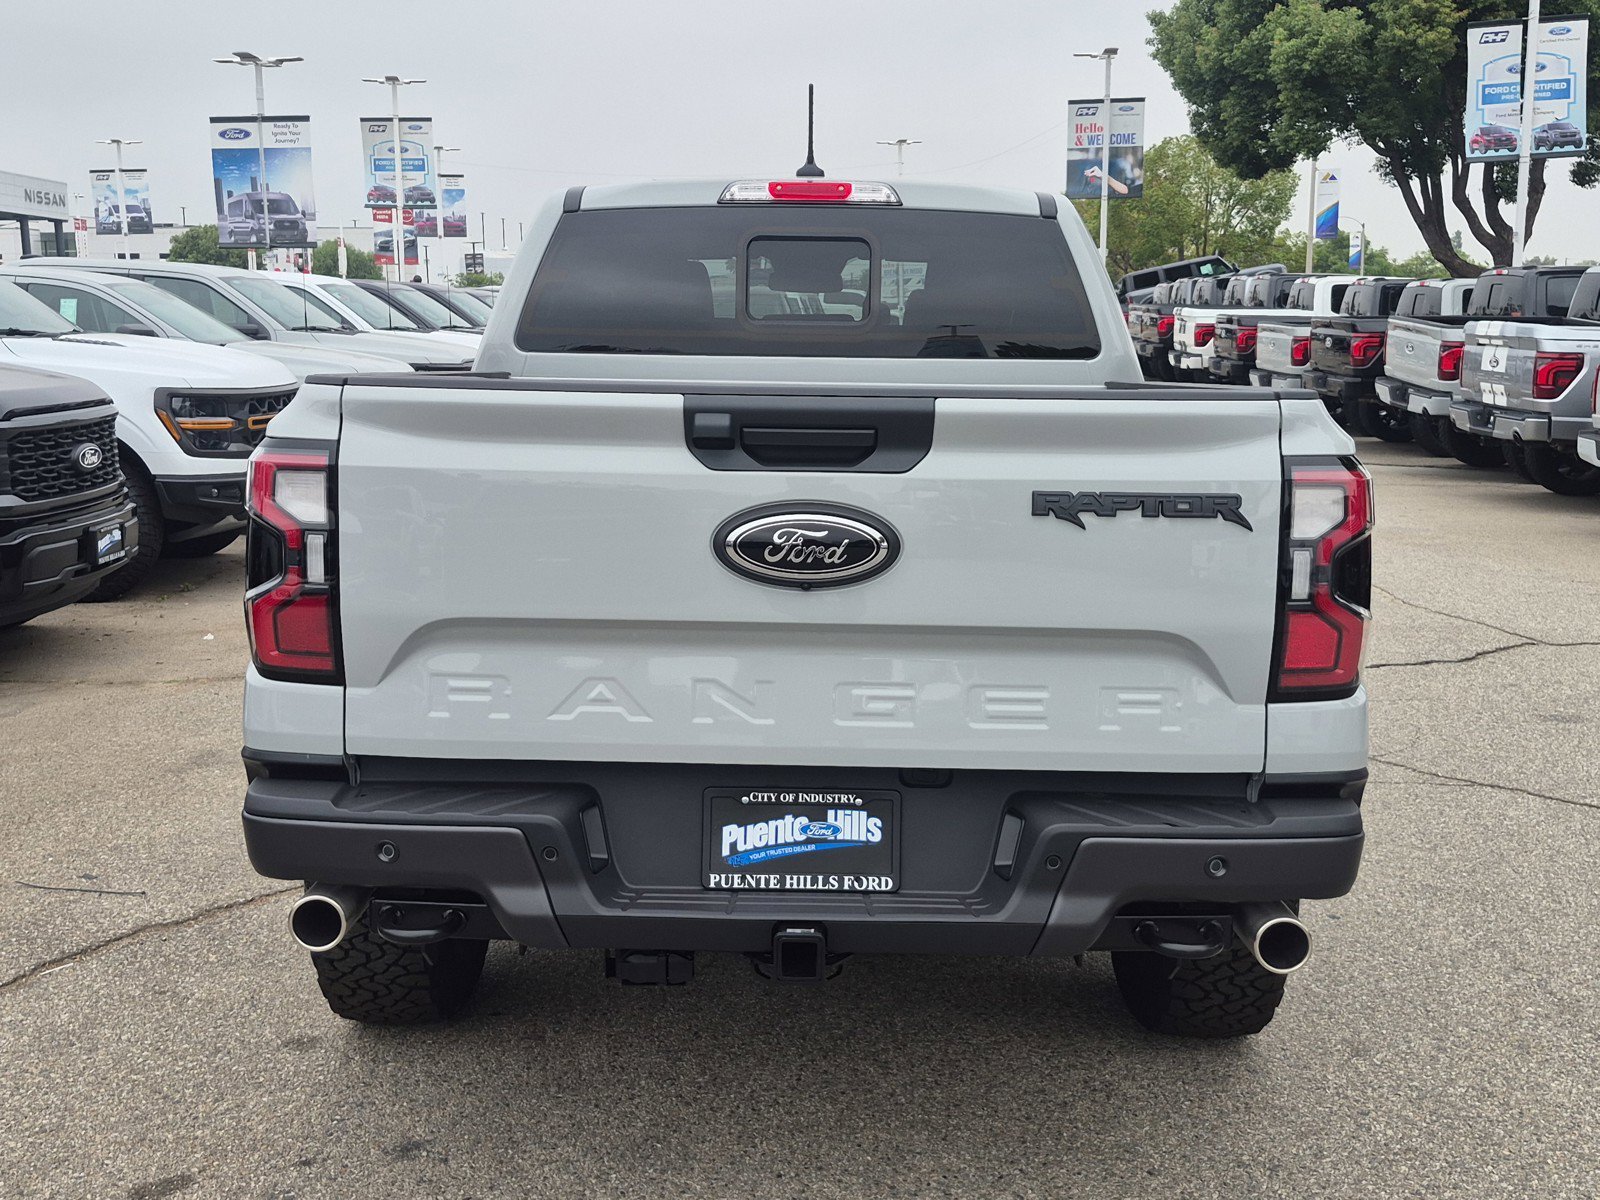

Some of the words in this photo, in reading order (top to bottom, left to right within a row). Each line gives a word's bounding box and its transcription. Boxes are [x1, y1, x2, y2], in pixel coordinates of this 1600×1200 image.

[1485, 86, 1509, 94] FORD
[1501, 91, 1551, 100] PRE-ONED
[1075, 123, 1104, 134] Hello
[1075, 135, 1083, 146] &
[24, 188, 66, 208] NISSAN
[84, 449, 99, 465] Ford
[1032, 490, 1254, 533] RAPTOR
[764, 527, 850, 565] Ford
[426, 672, 1184, 732] RANGER
[750, 792, 777, 802] CITY
[780, 793, 795, 803] OF
[799, 793, 856, 804] INDUSTRY
[721, 814, 809, 857] Puente
[827, 809, 883, 843] Hills
[749, 852, 766, 860] YOUR
[766, 848, 793, 856] TRUSTED
[793, 844, 816, 852] DEALER
[709, 873, 780, 889] PUENTE
[784, 875, 839, 890] HILLS
[843, 875, 894, 891] FORD
